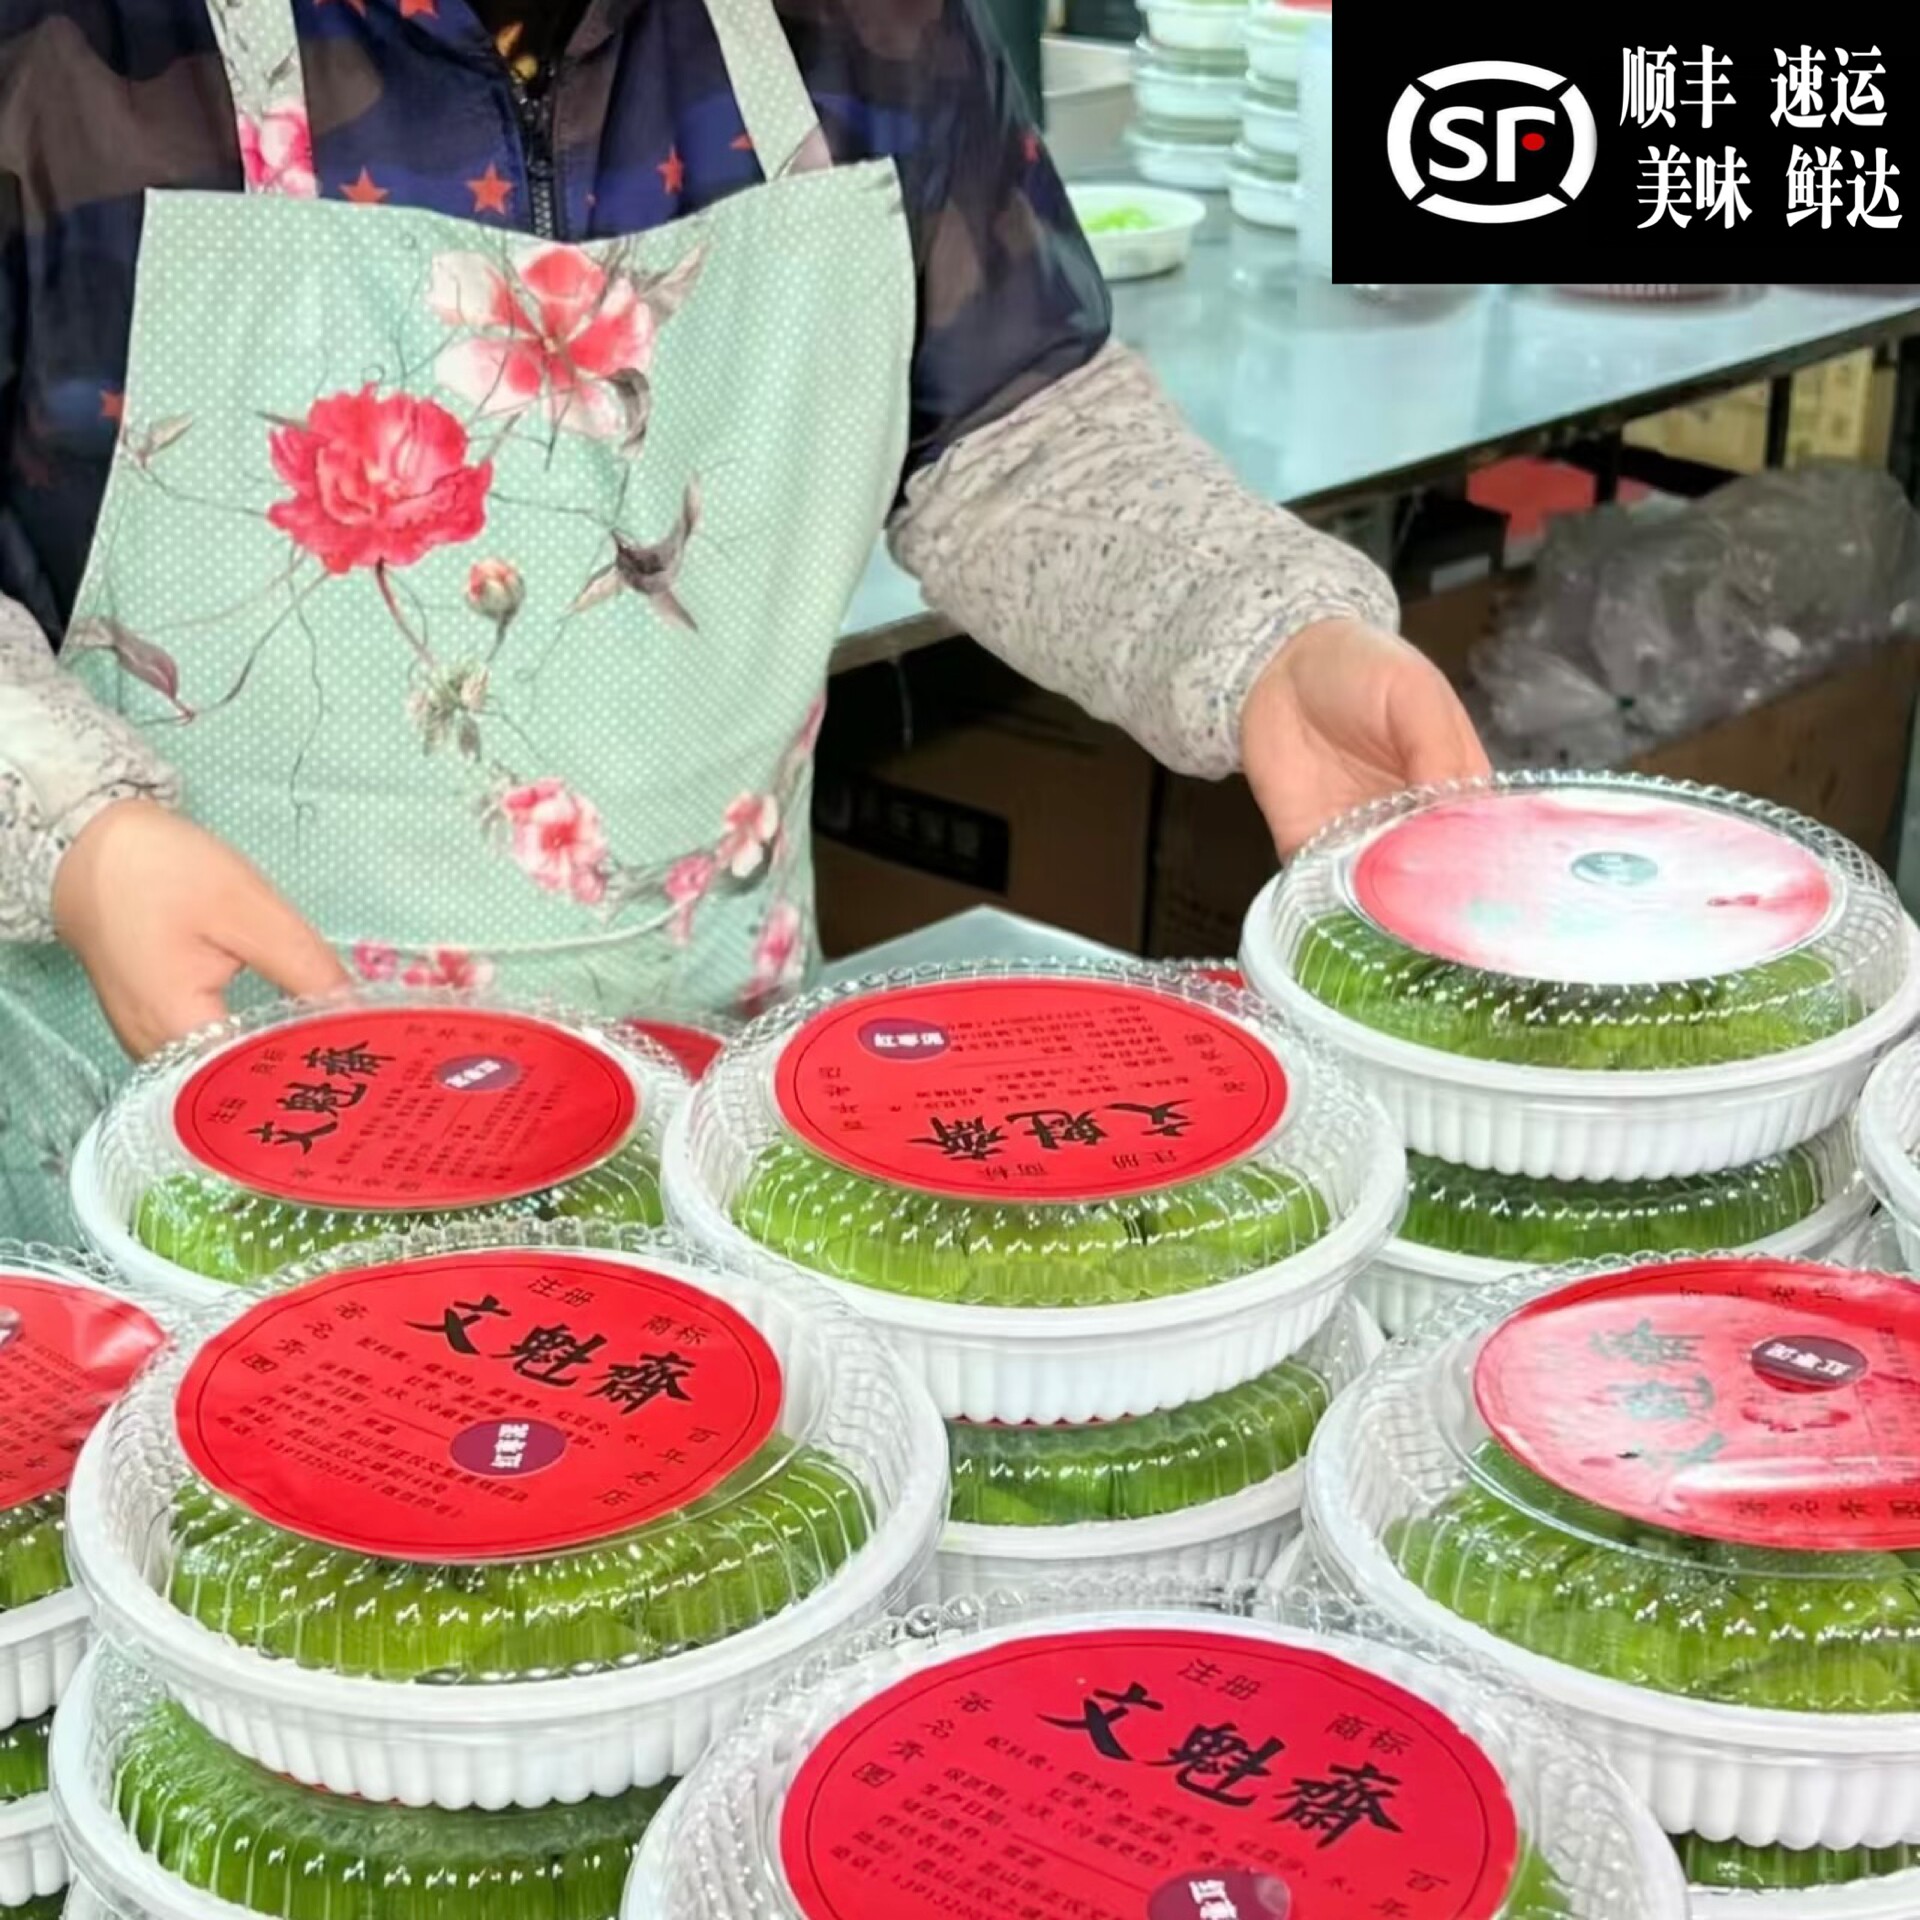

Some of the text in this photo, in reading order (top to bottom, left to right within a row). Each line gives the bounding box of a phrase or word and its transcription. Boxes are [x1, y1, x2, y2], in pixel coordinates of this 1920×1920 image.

[528, 1276, 595, 1307] 注册
[1177, 1658, 1415, 1756] 注册 商标
